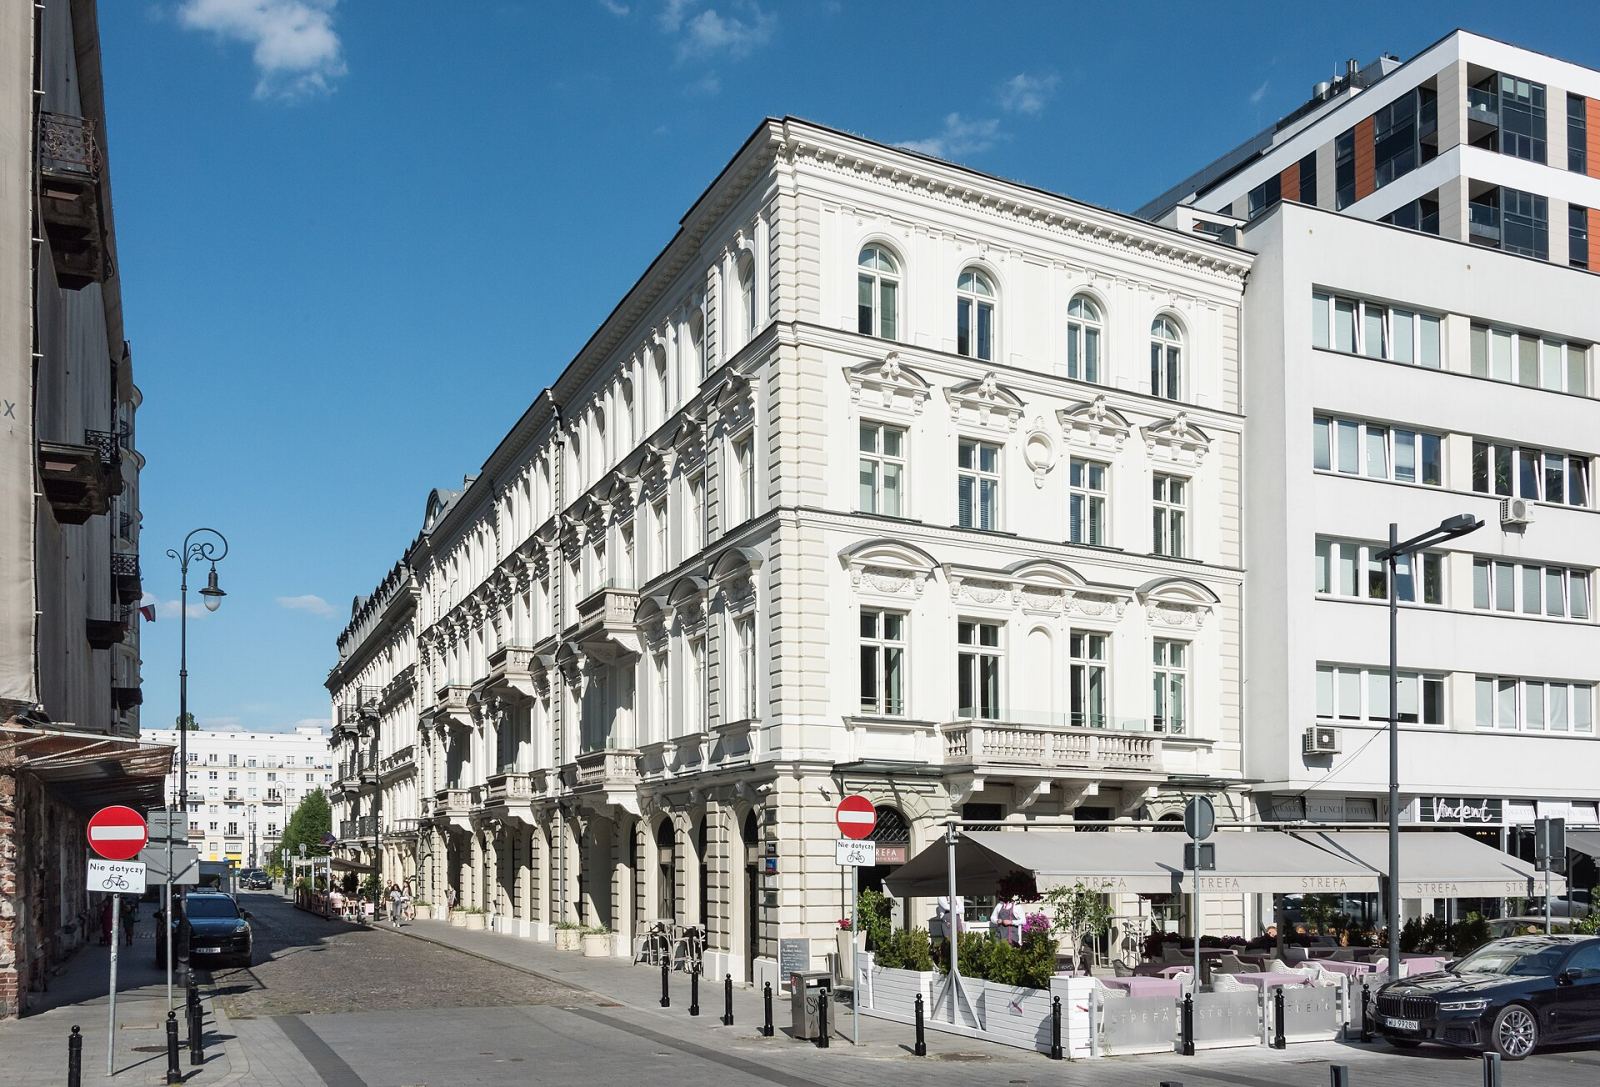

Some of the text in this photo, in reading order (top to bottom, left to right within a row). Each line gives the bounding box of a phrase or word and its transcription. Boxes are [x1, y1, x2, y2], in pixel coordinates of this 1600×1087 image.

[851, 843, 874, 851] dotyczy
[89, 863, 144, 875] Nie dotyczy
[1192, 878, 1240, 888] TREFA
[1302, 878, 1347, 888] STREFA
[1417, 883, 1458, 893] STREFA
